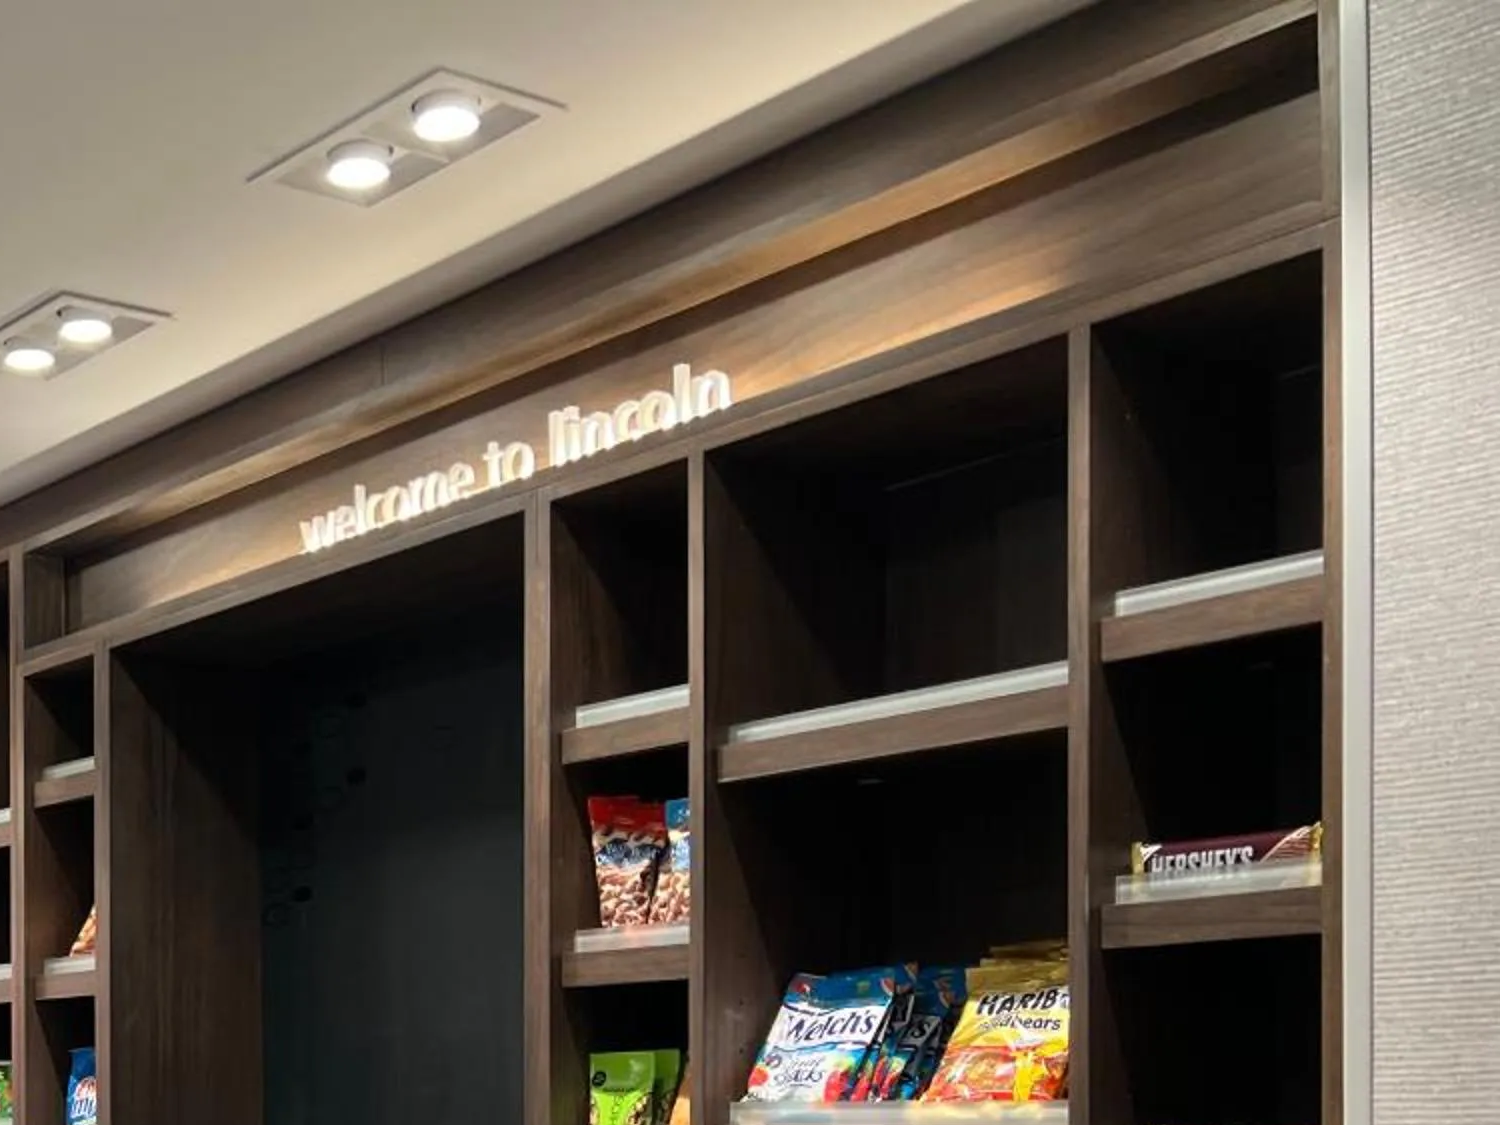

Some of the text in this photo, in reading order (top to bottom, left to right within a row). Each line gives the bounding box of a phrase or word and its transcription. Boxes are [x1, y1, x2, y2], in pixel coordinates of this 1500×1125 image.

[299, 362, 734, 554] welcome to lincoln
[787, 1009, 877, 1043] Welch's
